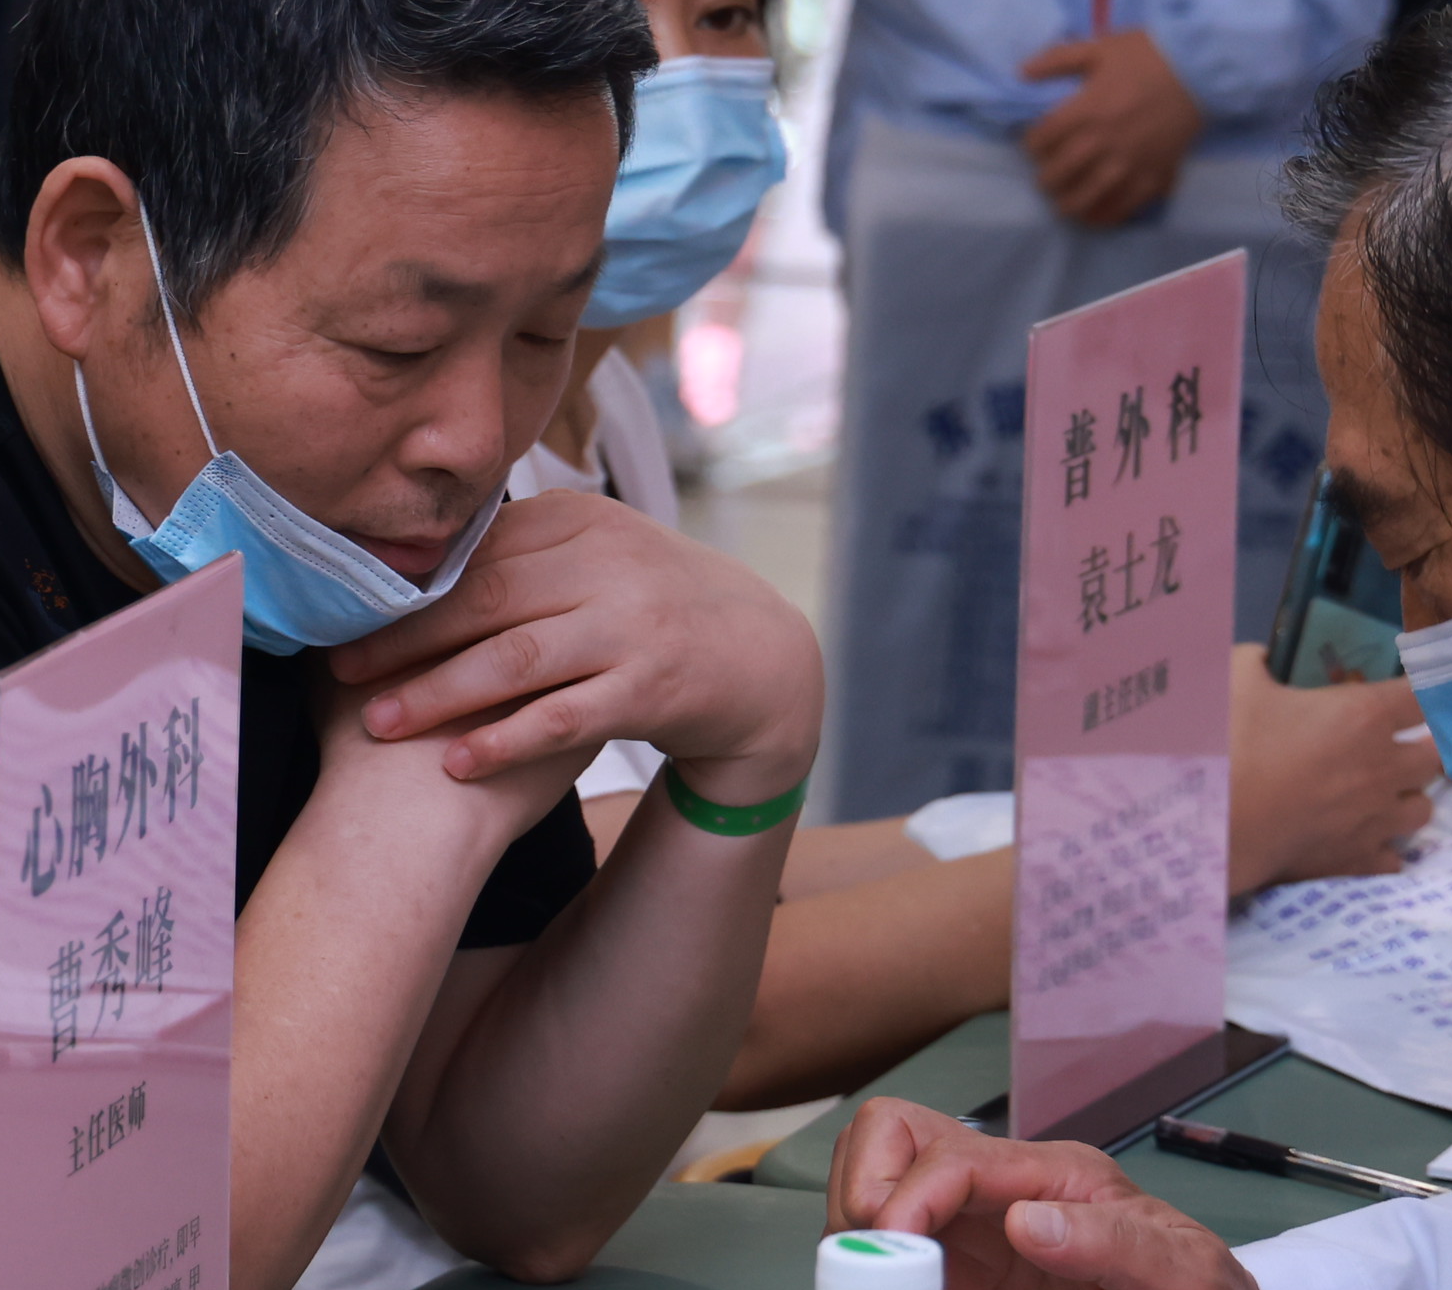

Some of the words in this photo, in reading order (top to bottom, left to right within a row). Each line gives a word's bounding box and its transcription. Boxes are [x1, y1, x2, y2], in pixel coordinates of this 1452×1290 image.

[1059, 366, 1203, 508] 普外科
[21, 696, 204, 898] 心胸外科
[48, 886, 175, 1064] 曹秀峰
[67, 1081, 147, 1177] 主任医师
